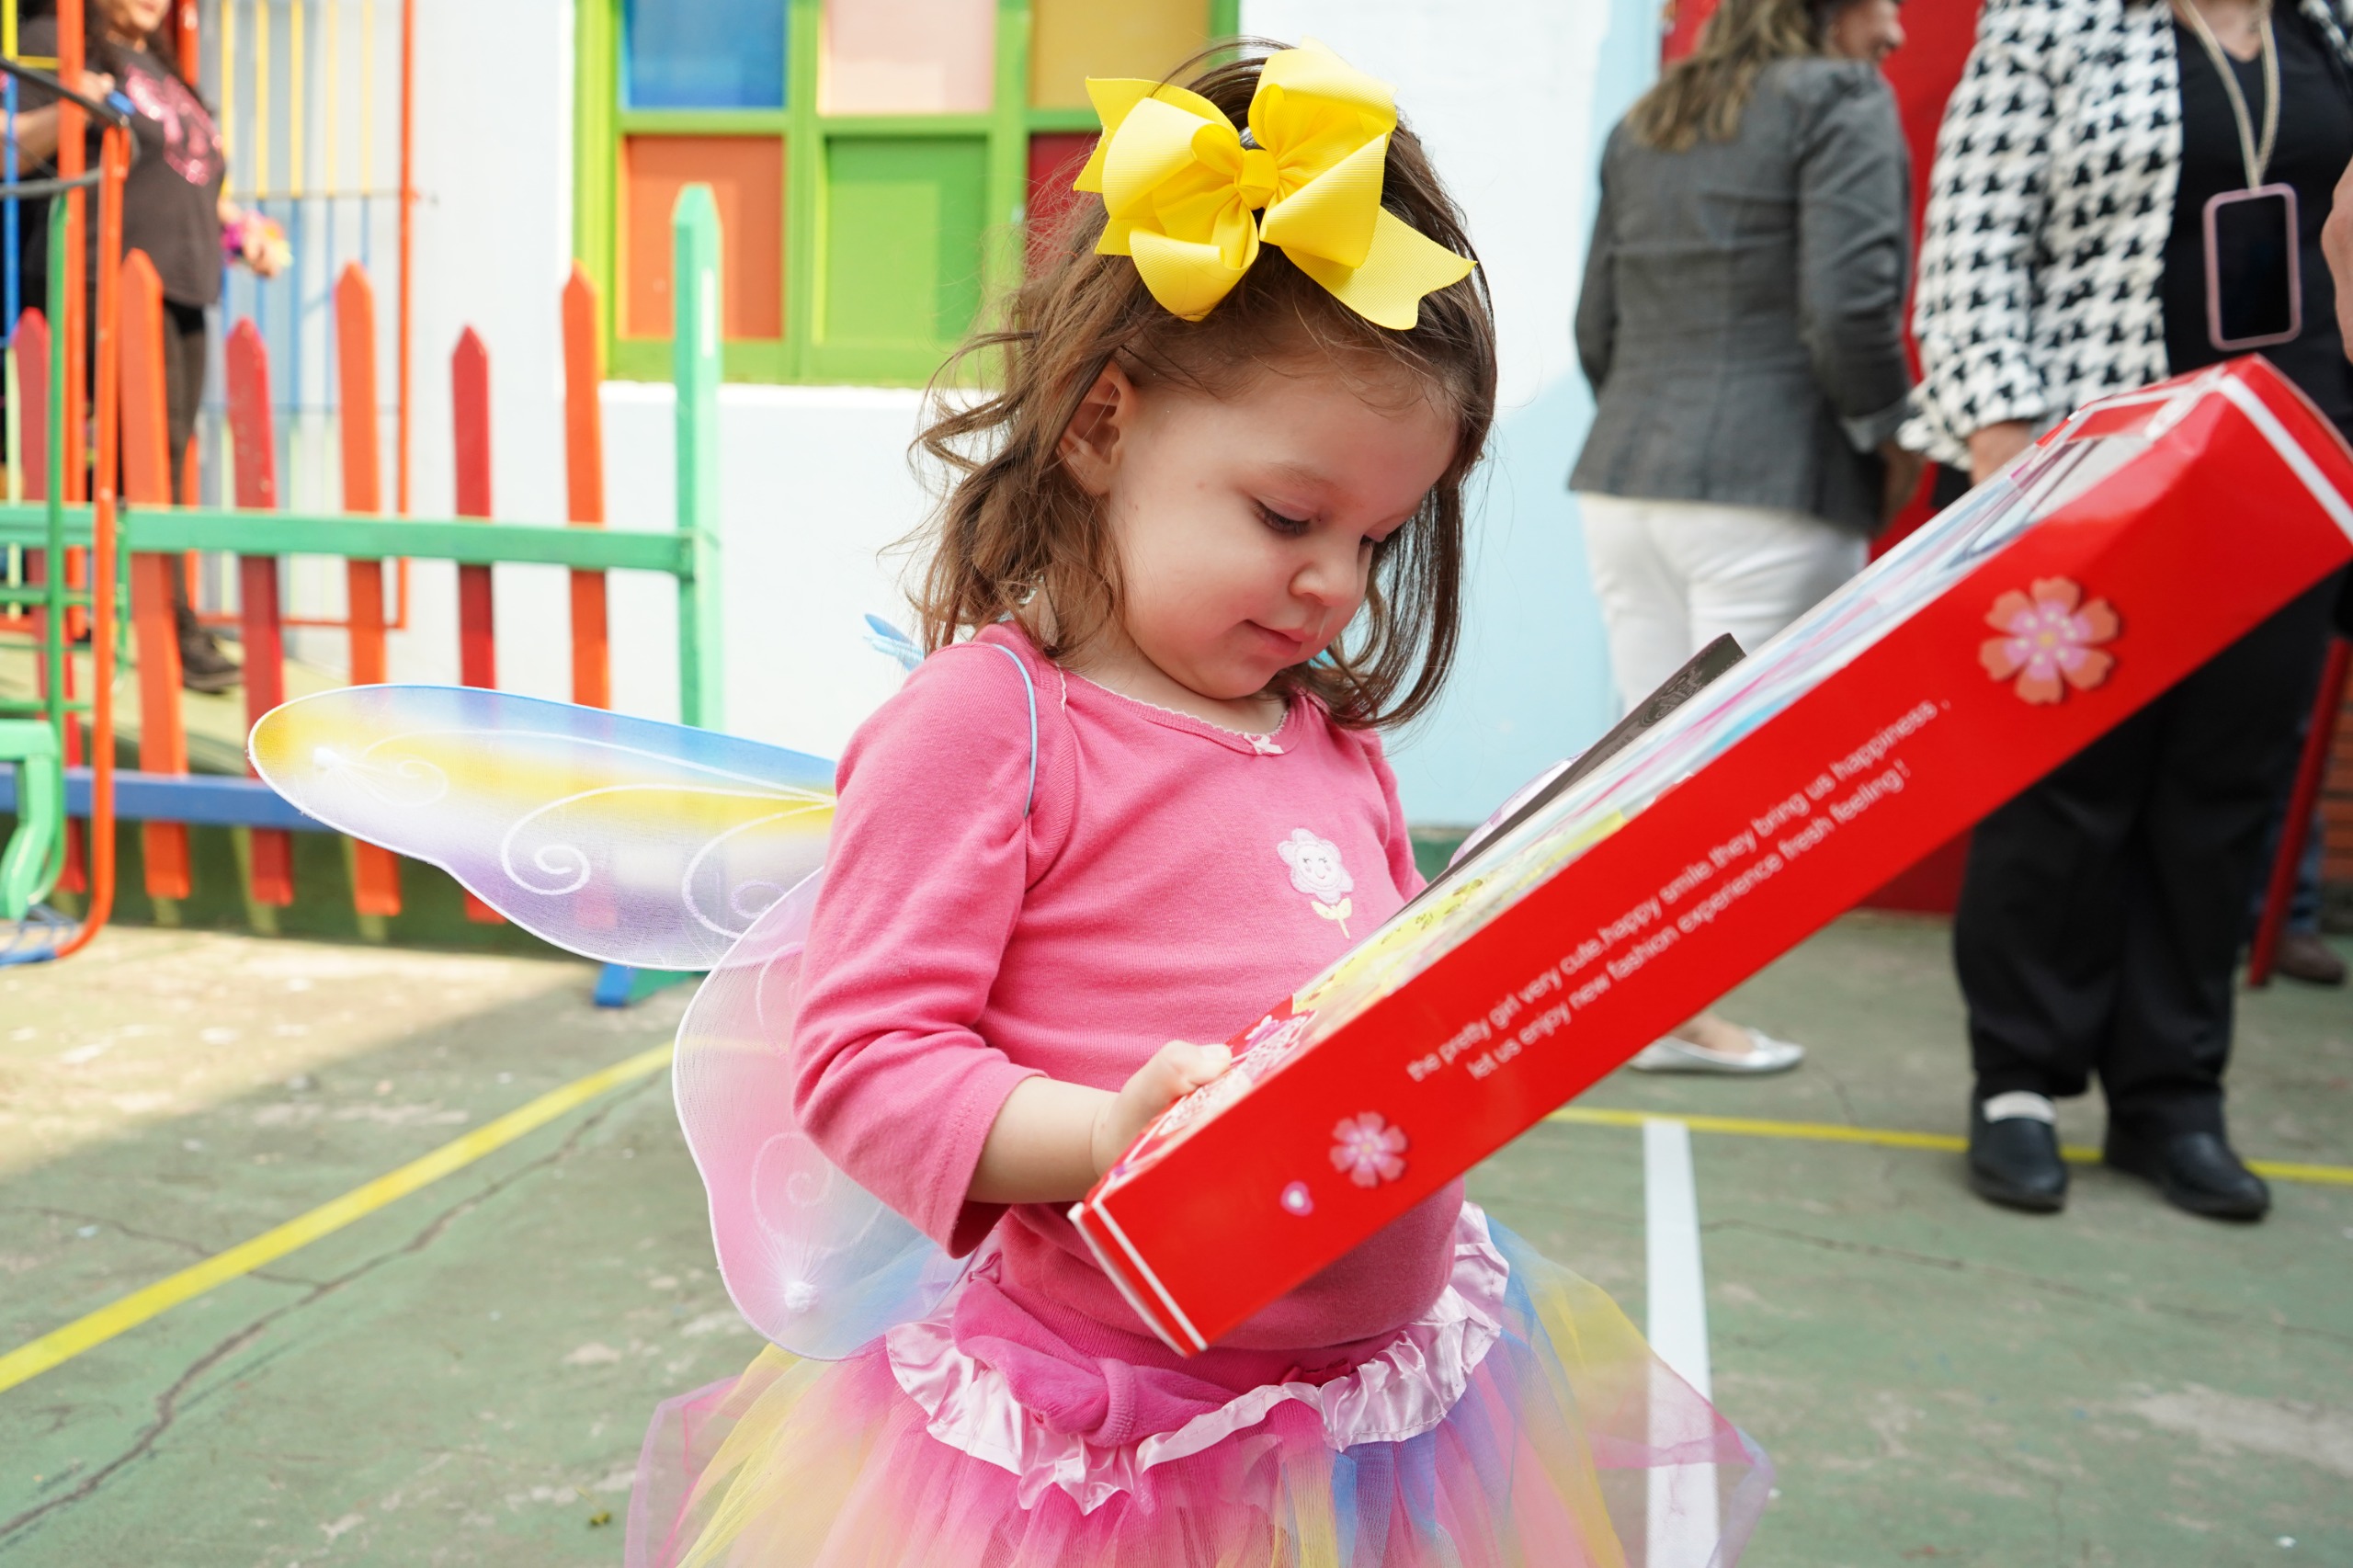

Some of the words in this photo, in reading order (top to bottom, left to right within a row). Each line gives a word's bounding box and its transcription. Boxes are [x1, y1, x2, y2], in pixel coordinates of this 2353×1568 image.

[1406, 1052, 1441, 1082] the
[1438, 1018, 1492, 1065] pretty
[1489, 994, 1522, 1029] girl
[1518, 968, 1563, 1004] very
[1751, 792, 1811, 837] bring
[1804, 773, 1836, 801] us
[1829, 700, 1938, 781] happiness
[1466, 1052, 1498, 1080] let
[1493, 1038, 1522, 1063] us
[1518, 1002, 1571, 1046] enjoy
[1568, 973, 1611, 1009] new
[1606, 926, 1680, 981] fashion
[1677, 853, 1783, 933] experience
[1778, 816, 1836, 860] fresh
